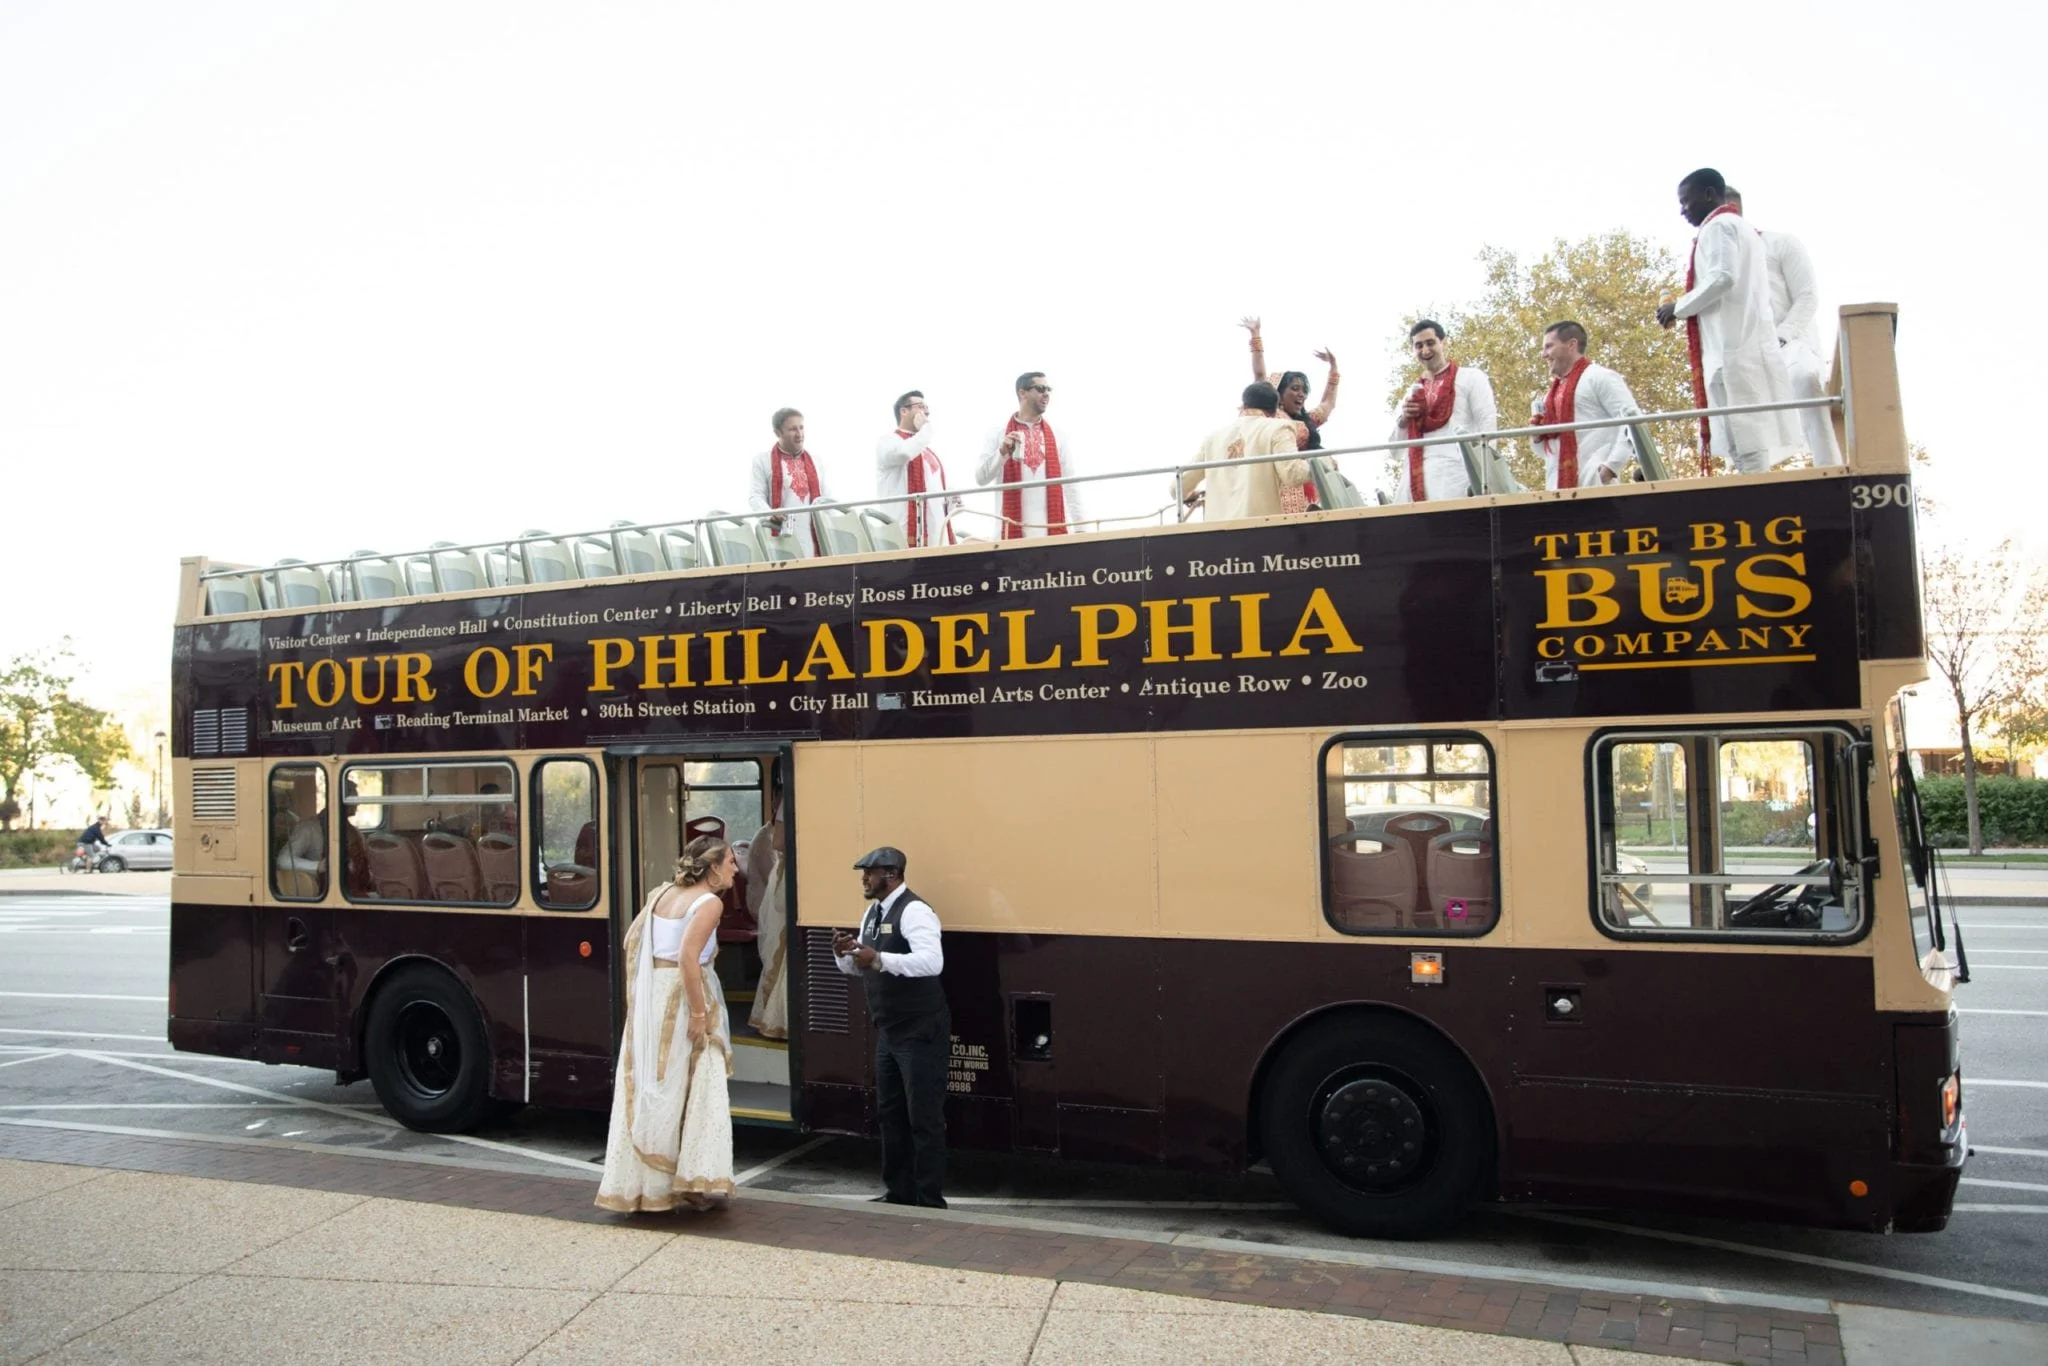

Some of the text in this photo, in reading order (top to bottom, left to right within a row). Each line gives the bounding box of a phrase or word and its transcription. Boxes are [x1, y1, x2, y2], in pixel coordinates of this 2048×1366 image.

[1851, 482, 1912, 510] 390
[1534, 525, 1661, 561] THE
[269, 553, 1362, 651] Visitor Center Independence Hall Constitution Center Liberty Bell Betsy Ross House Franklin Court Rodin Museum
[1533, 552, 1812, 630] BUS
[268, 587, 1364, 709] TOUR OF PHILADELPHIA
[1536, 624, 1813, 658] COMPANY
[271, 670, 1368, 733] Museum of Art Reading Terminal Market 30th Street Station City Hall Kimmel Arts Center Antique Row Zoo
